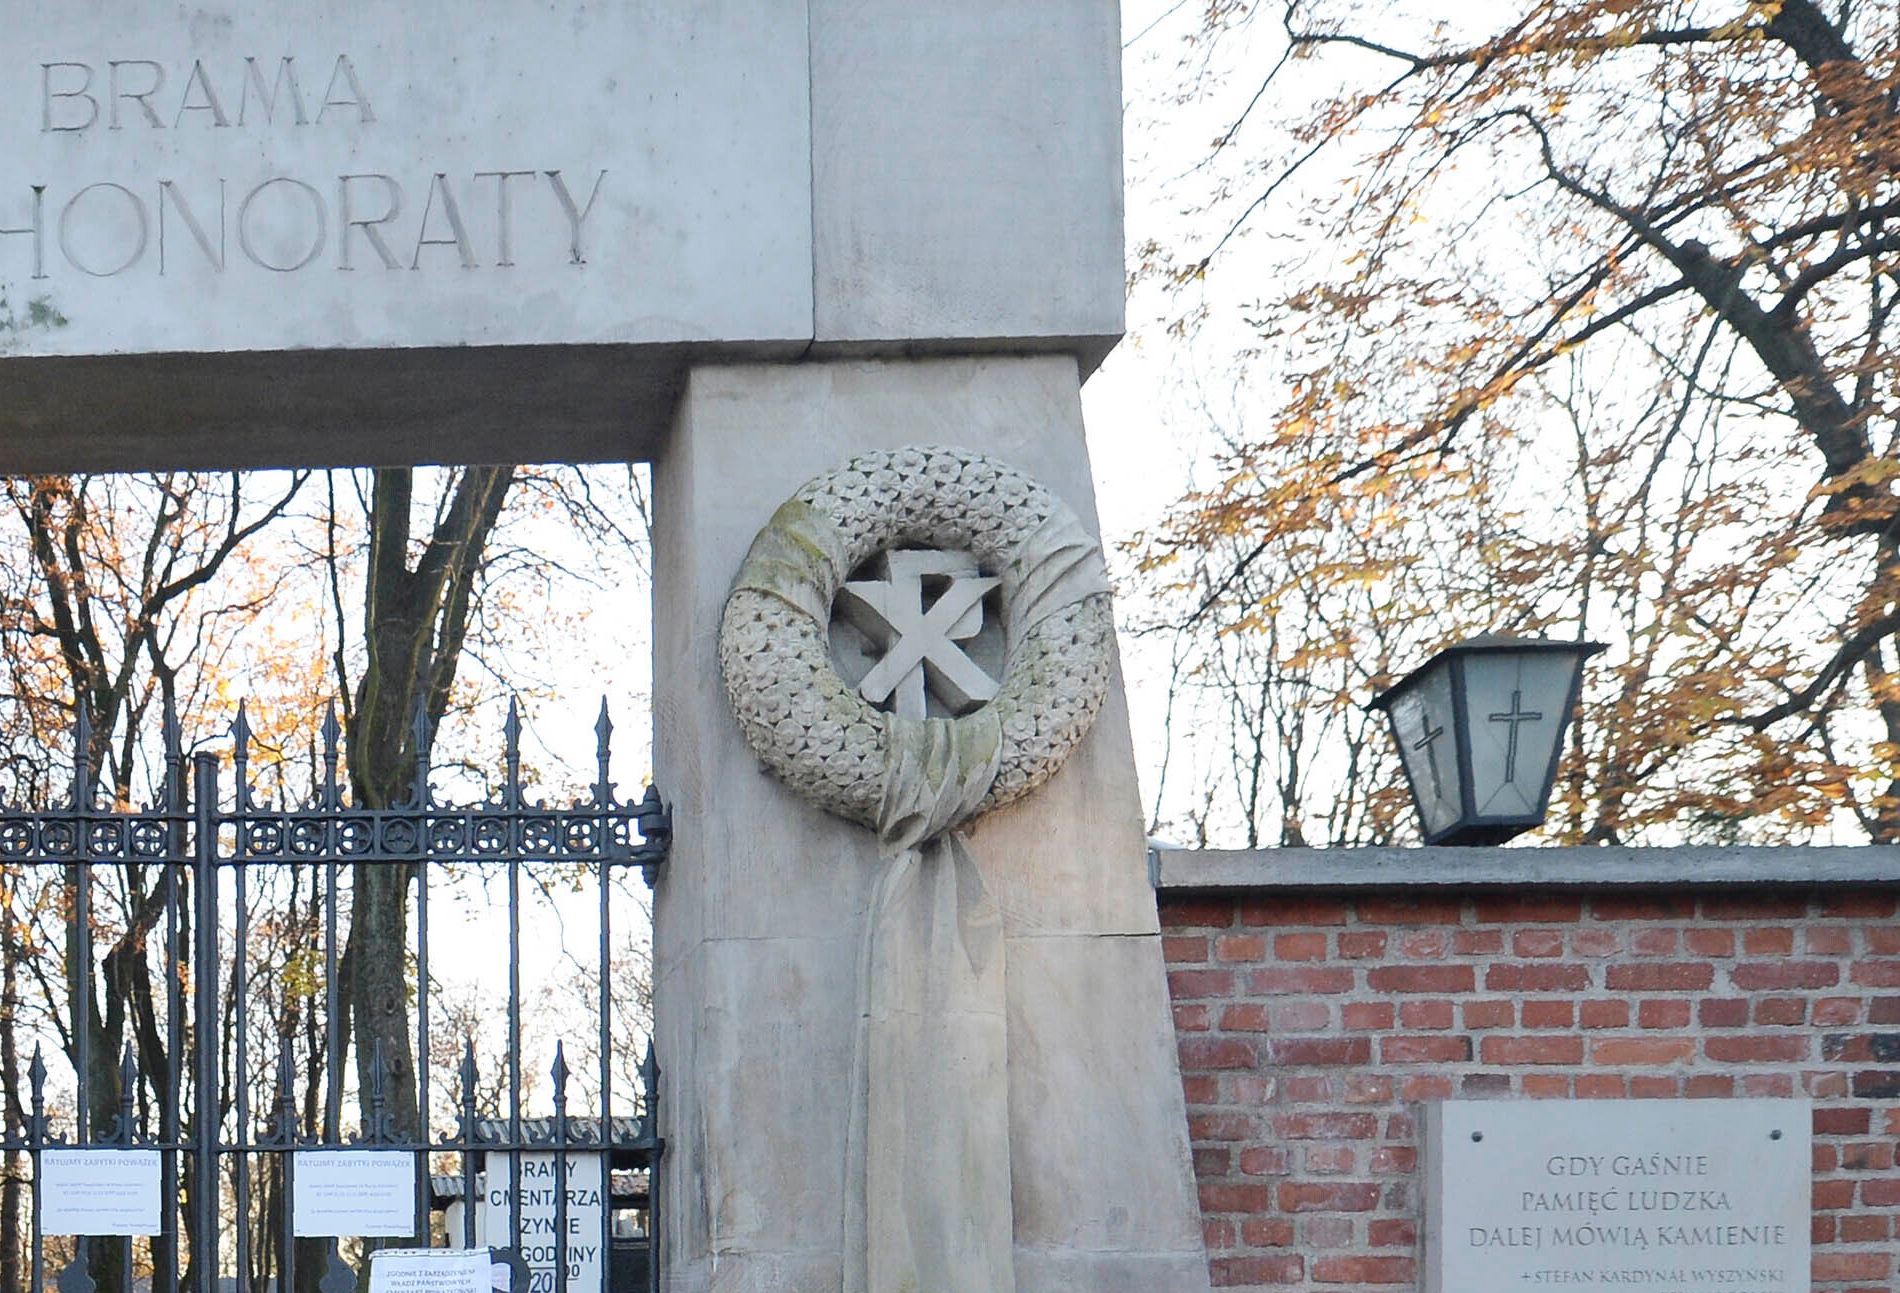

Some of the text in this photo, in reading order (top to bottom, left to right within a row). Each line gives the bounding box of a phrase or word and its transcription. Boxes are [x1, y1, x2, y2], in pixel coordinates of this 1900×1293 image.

[39, 55, 377, 134] BRAMA
[1546, 1151, 1708, 1176] GDY GAŚNIE
[1521, 1186, 1732, 1217] PAMIĘĆ LUDZKA
[1469, 1222, 1786, 1250] DALEJ MÓWIĄ KAMIENIE
[520, 1246, 597, 1263] GODINY
